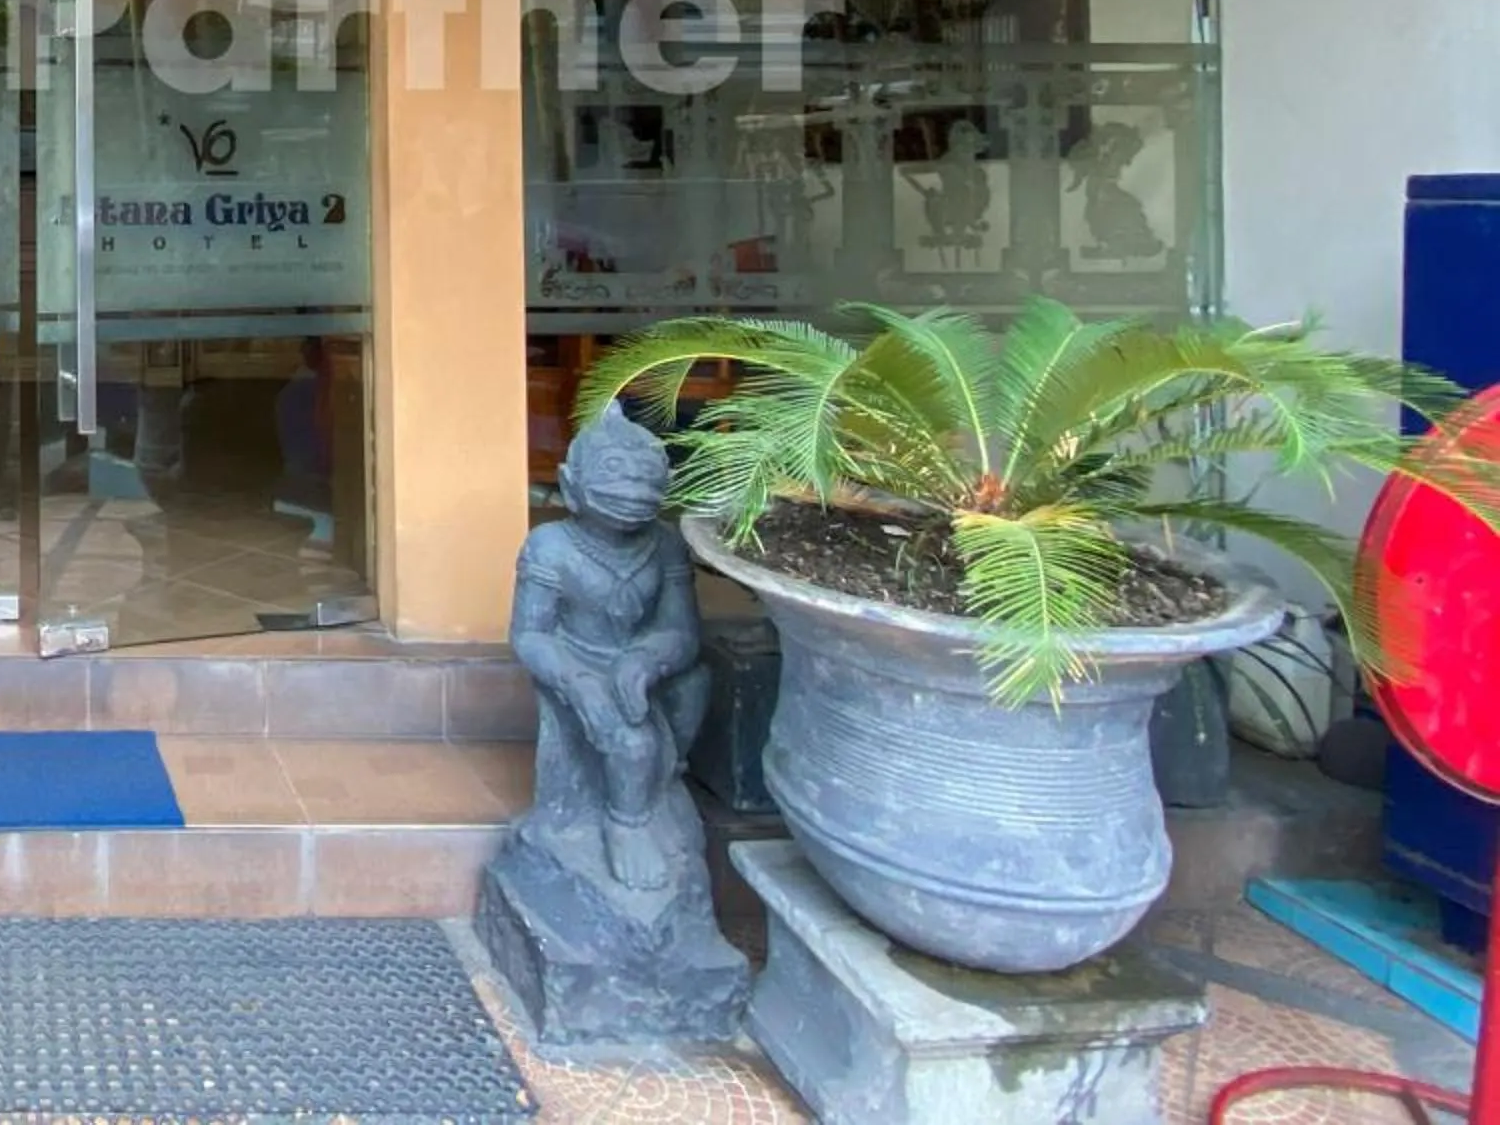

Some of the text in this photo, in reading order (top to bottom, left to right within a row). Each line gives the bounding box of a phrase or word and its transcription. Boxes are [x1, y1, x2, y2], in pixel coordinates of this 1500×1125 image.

[58, 192, 347, 232] Itana Griya 2
[101, 235, 308, 250] HOTEL
